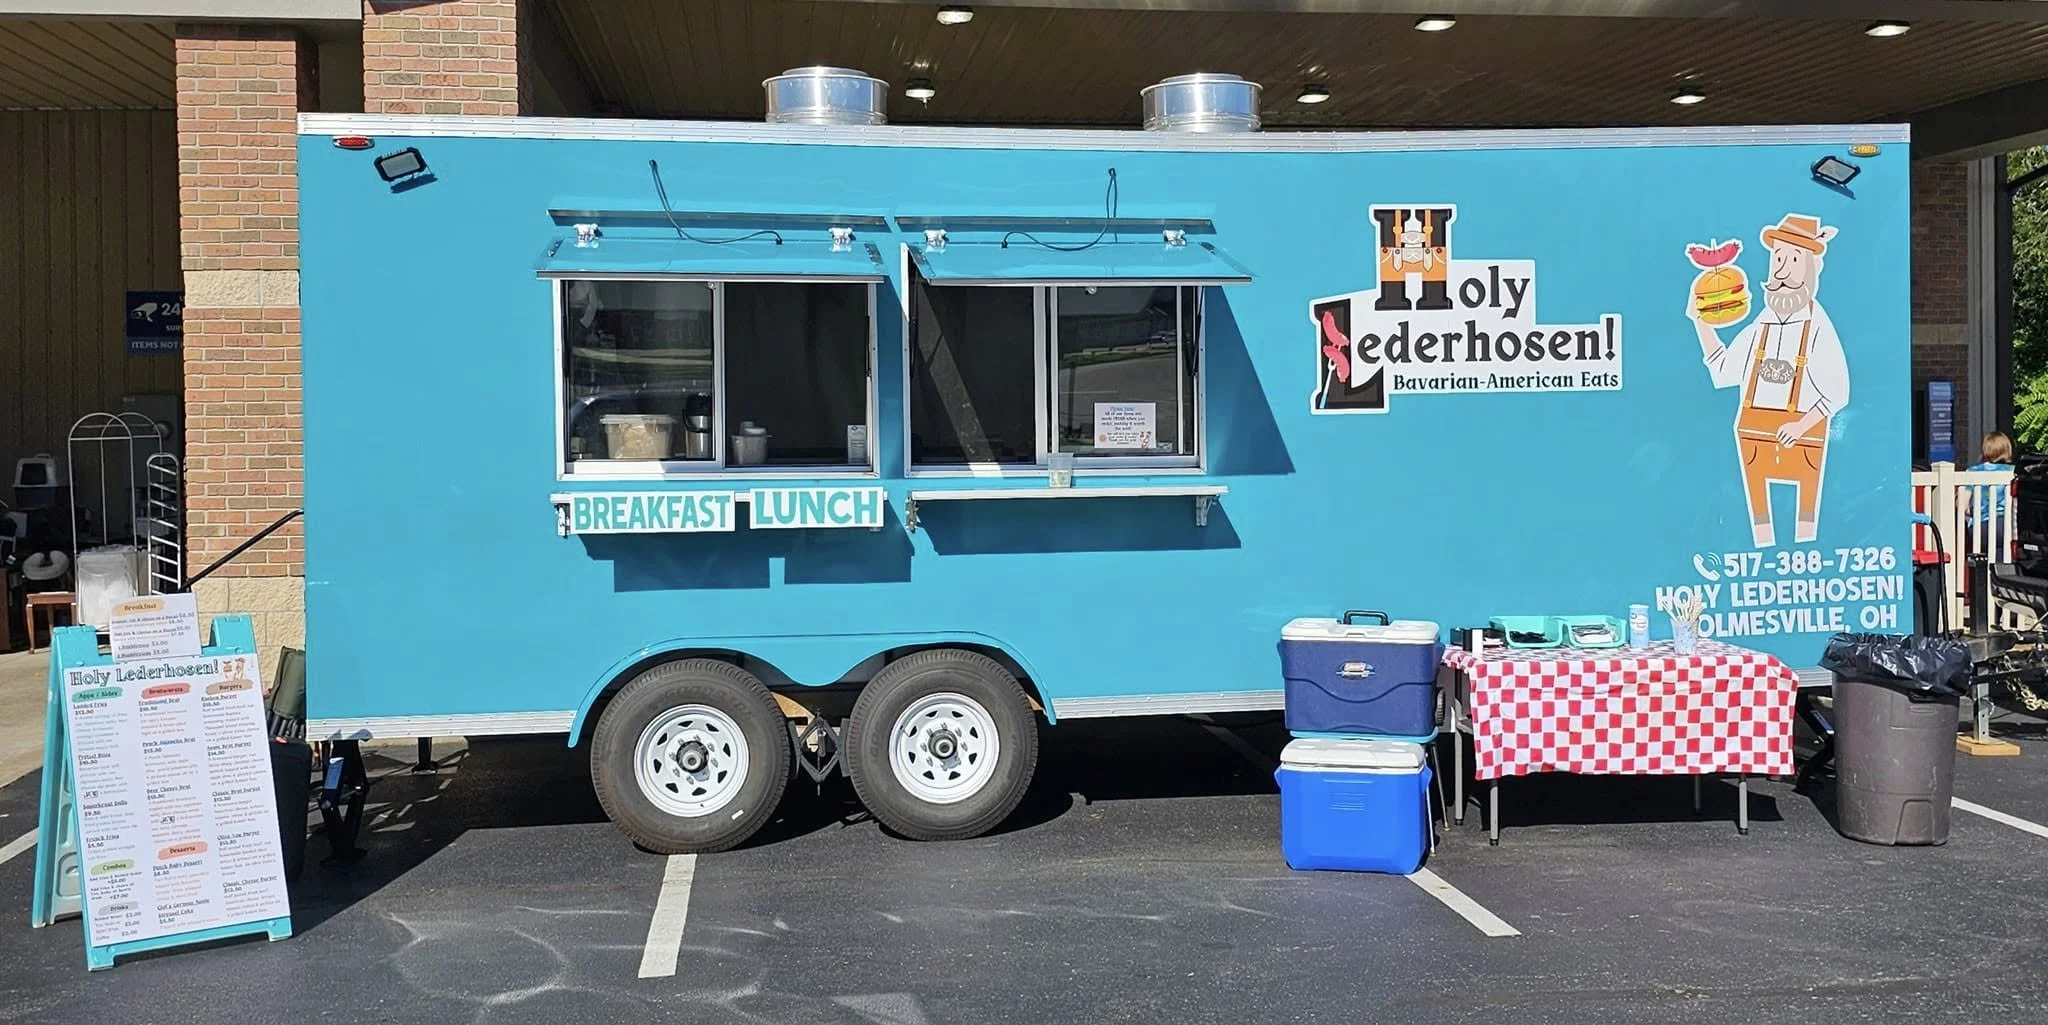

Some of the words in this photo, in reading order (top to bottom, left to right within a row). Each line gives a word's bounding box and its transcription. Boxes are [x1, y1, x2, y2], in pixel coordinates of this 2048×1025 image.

[1373, 208, 1531, 320] Holy
[161, 303, 181, 316] 24
[131, 341, 159, 349] ITEMS
[160, 341, 179, 349] NOT
[1312, 298, 1617, 410] Lederhosen!
[1393, 373, 1573, 392] Bavarian-American
[1581, 370, 1619, 389] Eats
[573, 494, 732, 530] BREAKFAST
[754, 490, 879, 526] LUNCH
[1723, 546, 1897, 578] 517-388-7326
[1655, 583, 1722, 612] HOLY
[1730, 575, 1905, 607] LEDERHOSEN!
[1698, 606, 1851, 637] OLMESVILLE,
[1859, 603, 1898, 630] OH
[70, 671, 111, 687] Holy
[116, 659, 219, 683] Lederhosen!
[79, 691, 94, 703] Apps
[102, 690, 118, 700] Sides
[219, 682, 243, 693] Burgers
[102, 863, 127, 872] Combos
